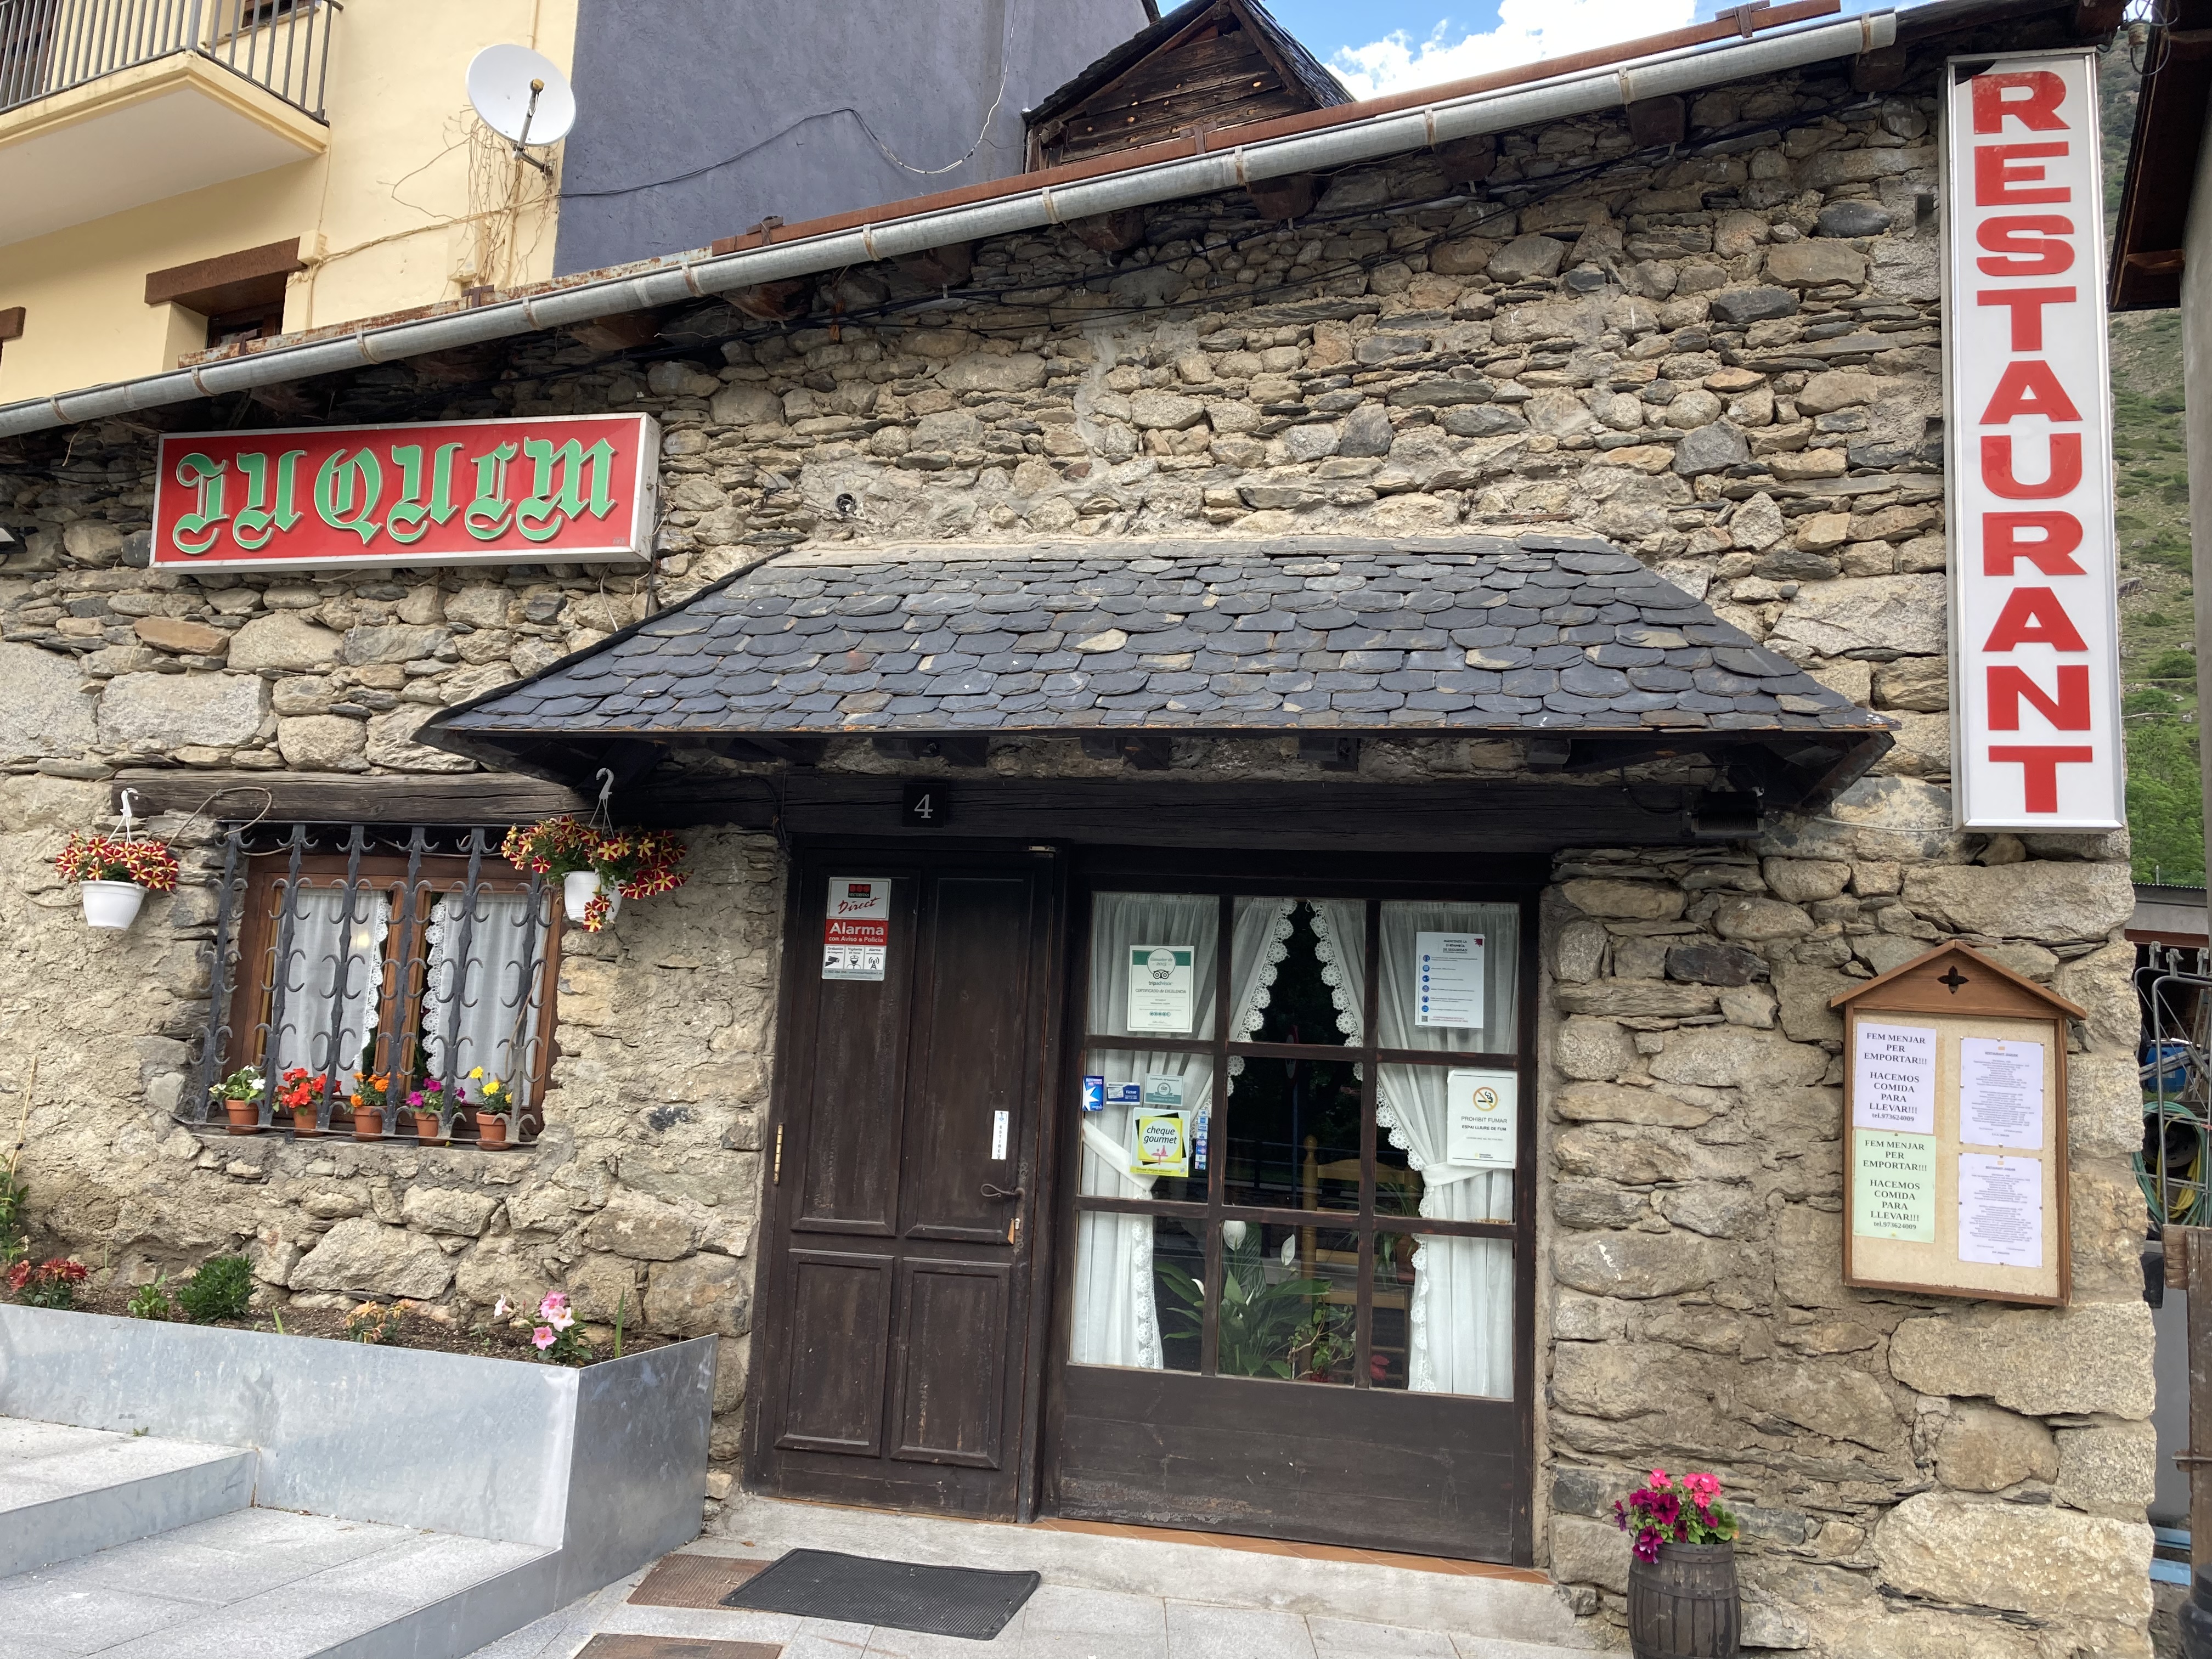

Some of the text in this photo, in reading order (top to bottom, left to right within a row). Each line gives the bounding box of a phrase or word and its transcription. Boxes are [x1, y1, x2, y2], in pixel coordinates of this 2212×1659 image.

[1972, 71, 2094, 813] RESTAURANT
[915, 794, 933, 818] 4
[838, 896, 881, 915] Direct
[829, 922, 884, 935] Alarma
[1866, 1032, 1926, 1044] FEM MENJAR
[1886, 1044, 1905, 1052] PER
[1864, 1052, 1927, 1065] EMPORTAR!!!
[1870, 1071, 1920, 1083] HACEMOS
[1874, 1082, 1915, 1092] COMIDA
[1881, 1093, 1906, 1102] PARA
[1869, 1103, 1917, 1114] LLEVAR!!!
[1147, 1125, 1175, 1136] cheque
[1143, 1136, 1177, 1144] gourmet
[1887, 1141, 1925, 1150] MENJAR
[1885, 1151, 1904, 1159] PER
[1863, 1160, 1927, 1172] EMPORTAR!!!
[1870, 1179, 1920, 1190] HACEMOS
[1874, 1190, 1915, 1200] COMIDA
[1882, 1201, 1908, 1210] PARA
[1870, 1211, 1919, 1222] LLEVAR!!!
[1874, 1221, 1916, 1229] tel.973624009
